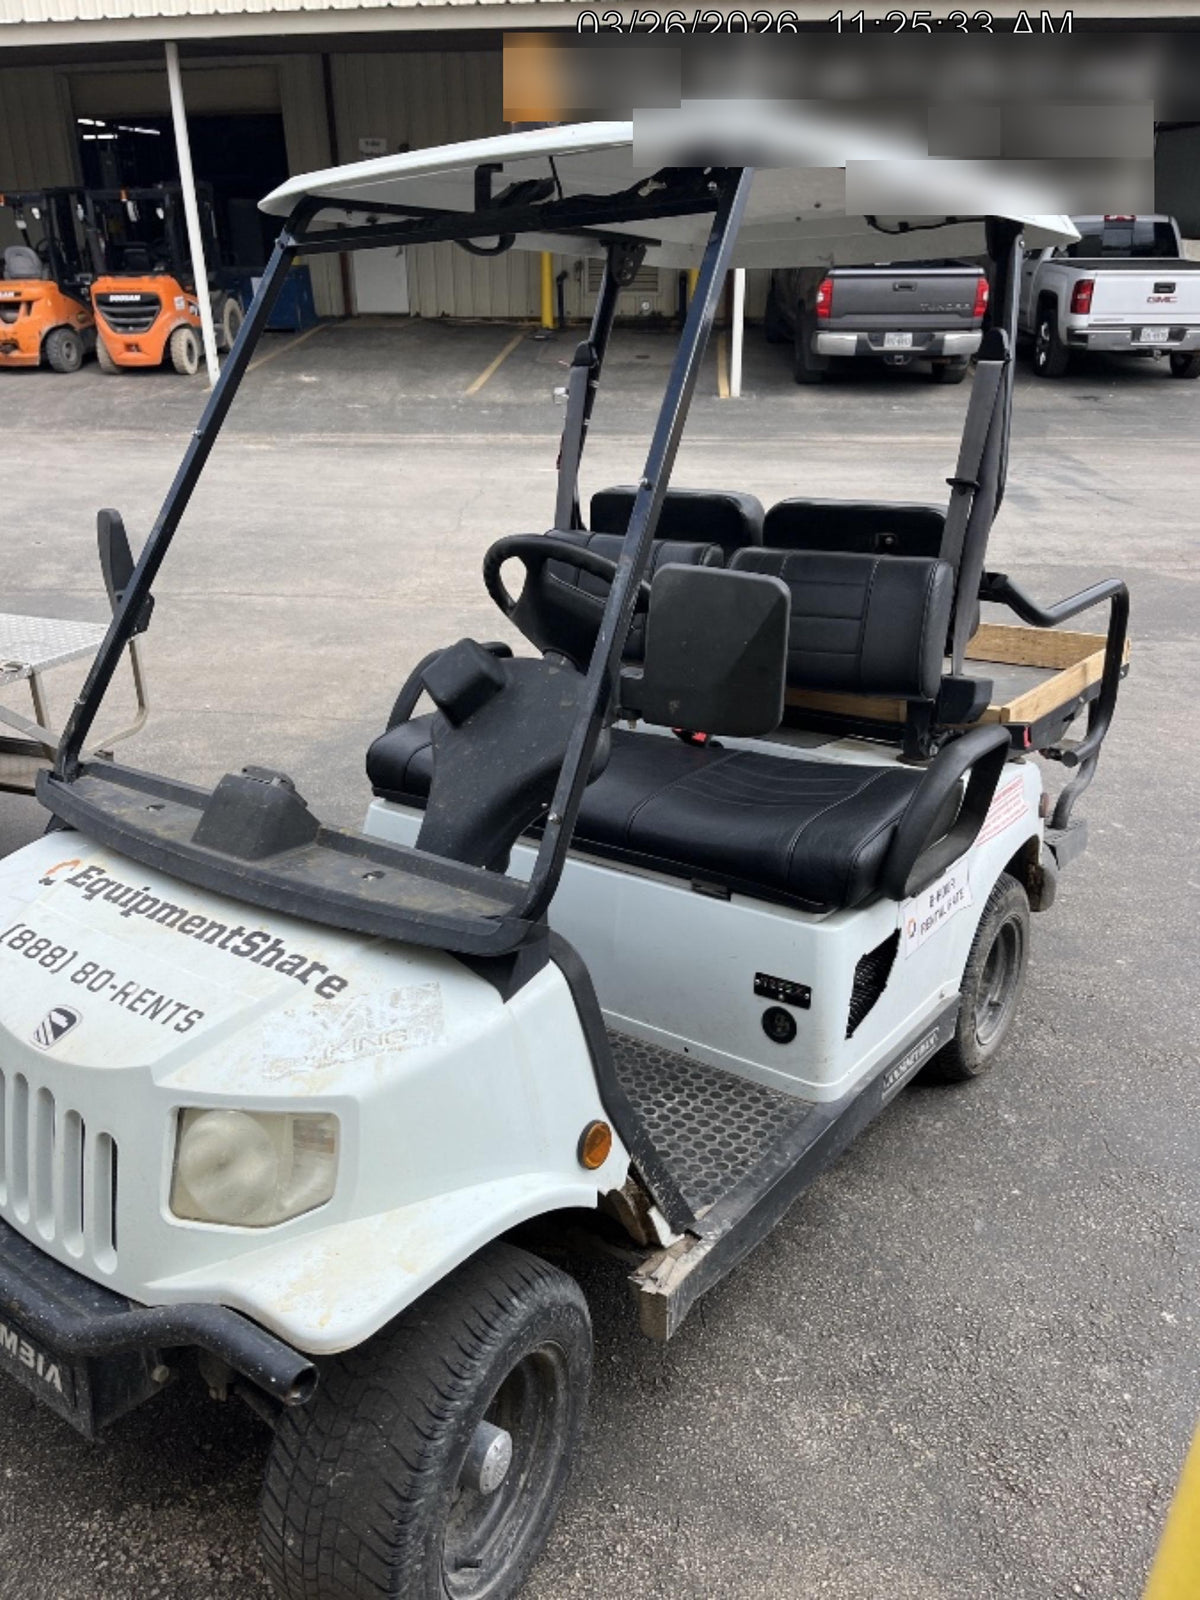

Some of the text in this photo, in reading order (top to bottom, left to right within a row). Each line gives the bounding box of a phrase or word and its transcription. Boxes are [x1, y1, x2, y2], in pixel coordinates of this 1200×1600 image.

[0, 923, 205, 1033] (888) 80-RENTS
[65, 865, 349, 1000] EquipmentShare
